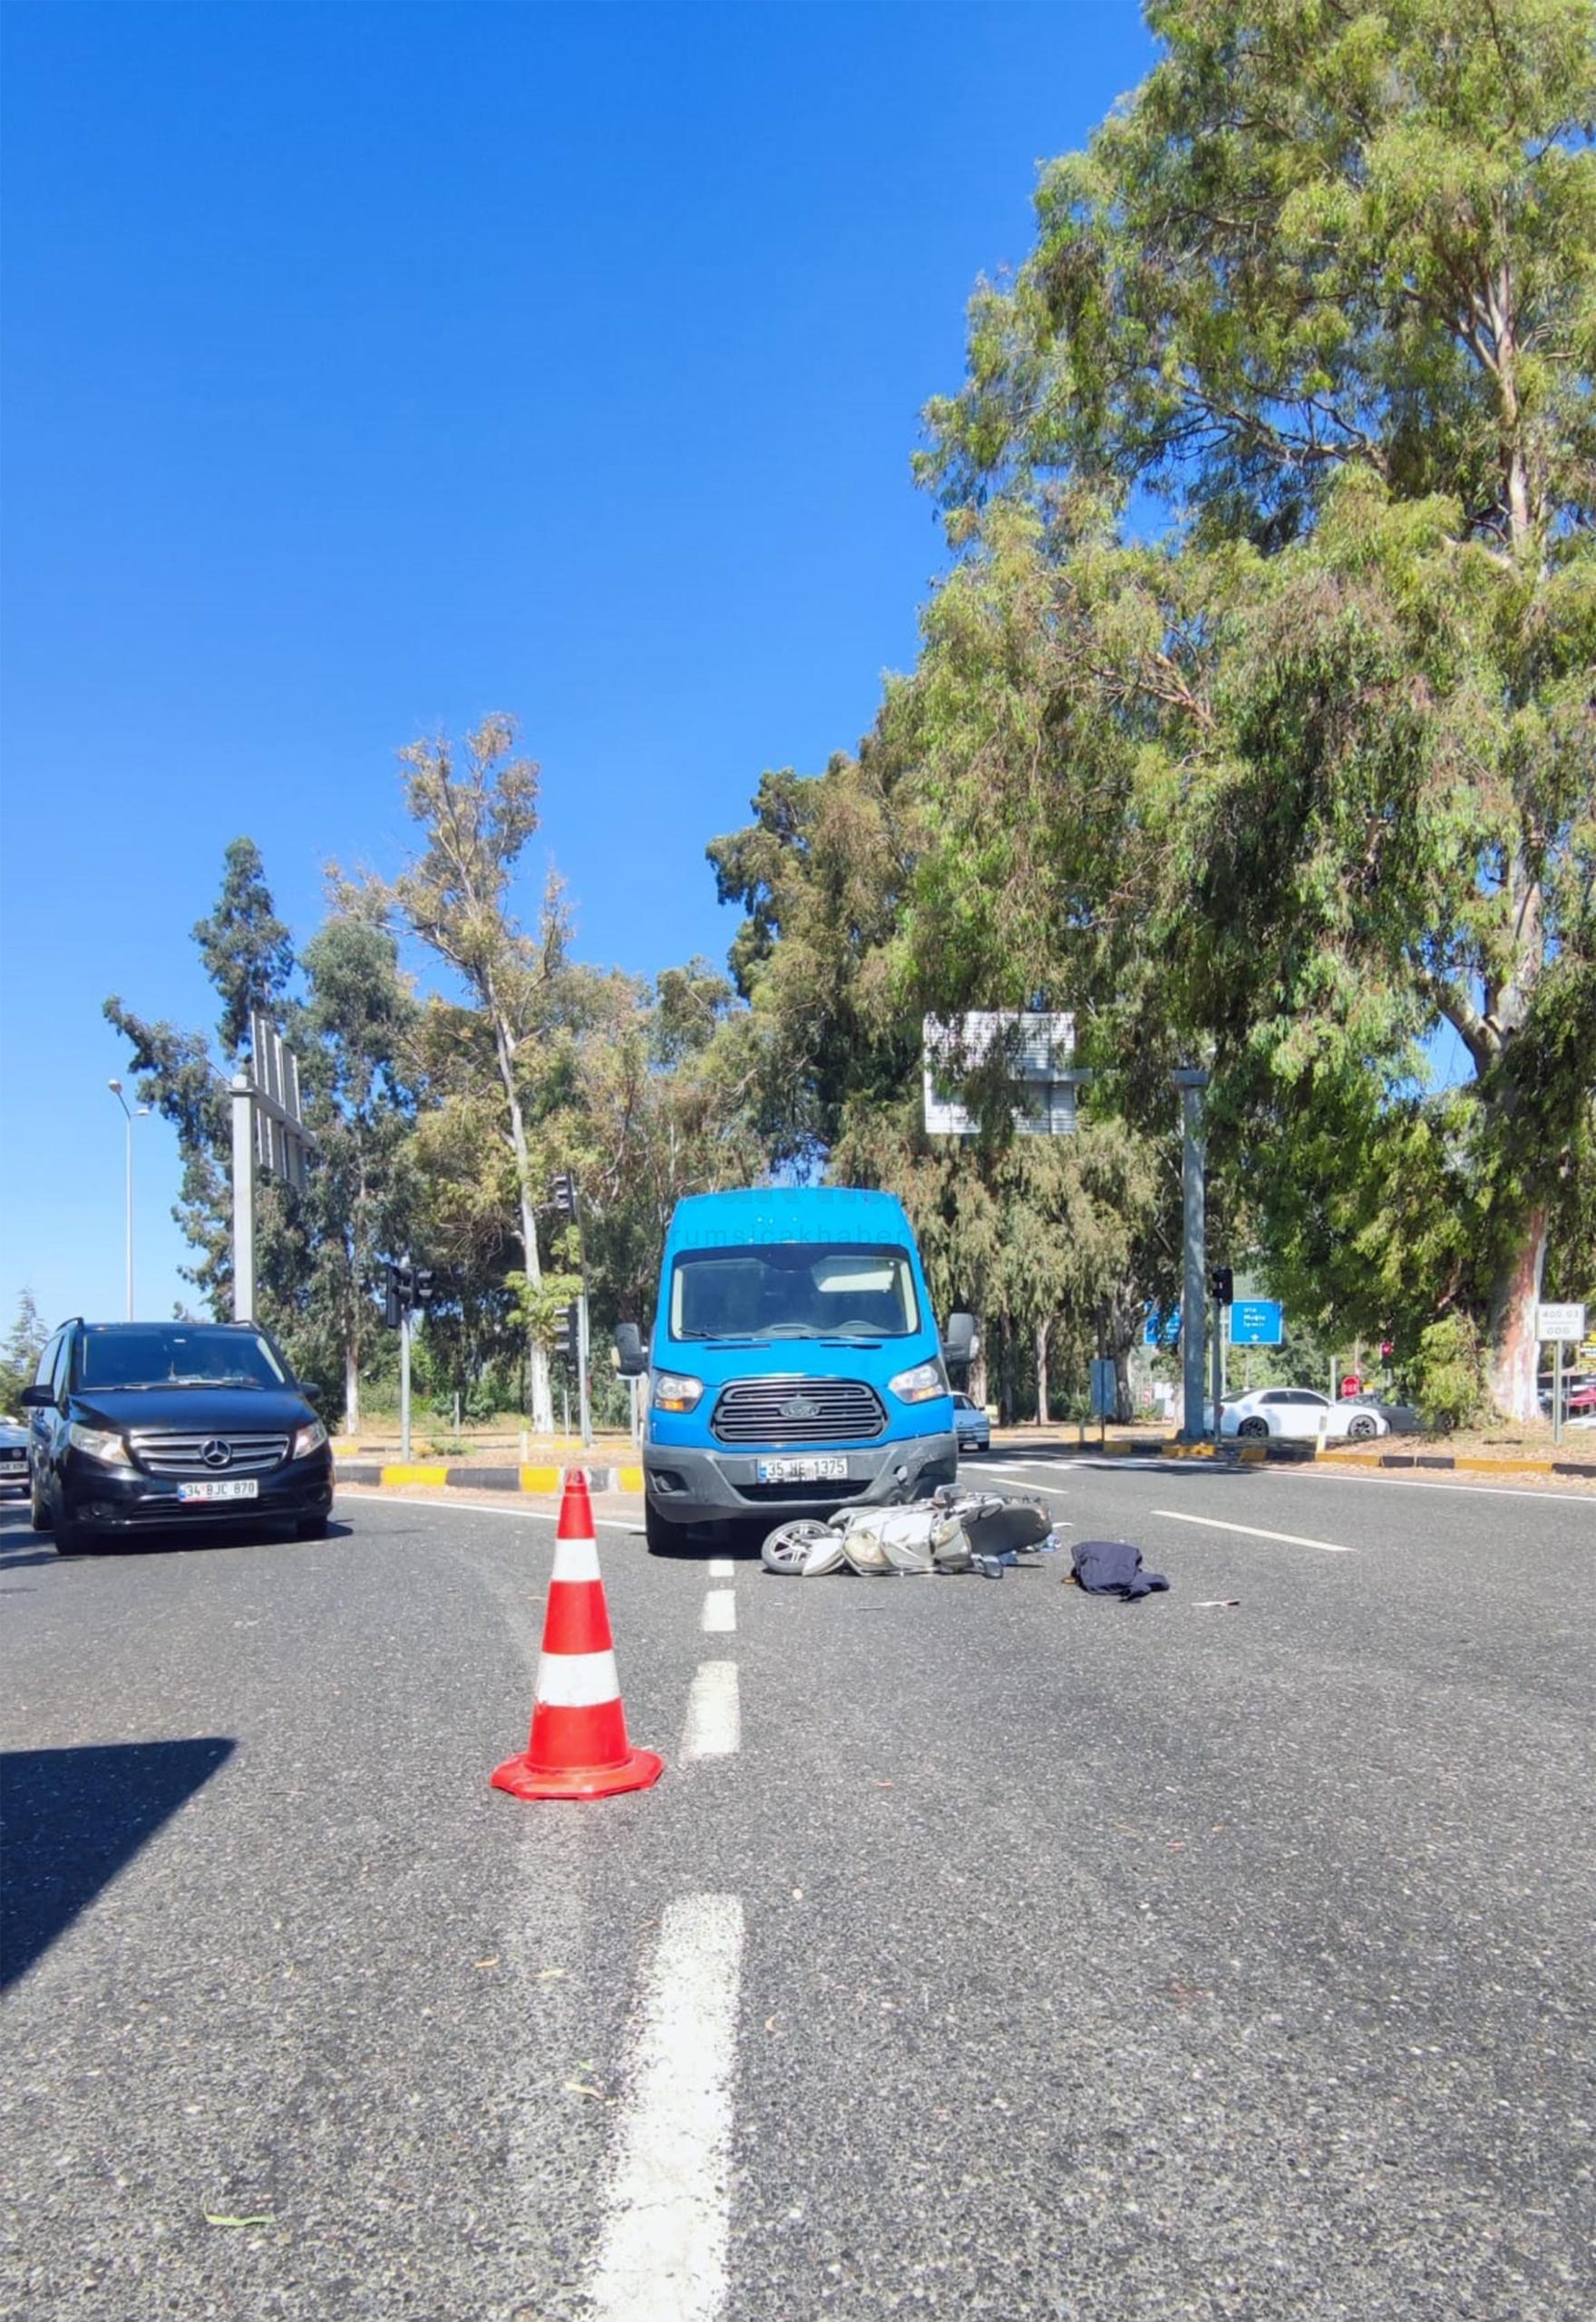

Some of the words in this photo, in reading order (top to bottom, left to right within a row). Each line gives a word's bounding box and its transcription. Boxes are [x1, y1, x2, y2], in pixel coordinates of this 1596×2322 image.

[768, 1461, 784, 1477] 35
[813, 1459, 845, 1475] 1375
[187, 1484, 201, 1498] 34
[207, 1483, 228, 1497] BJC
[233, 1482, 256, 1495] 870
